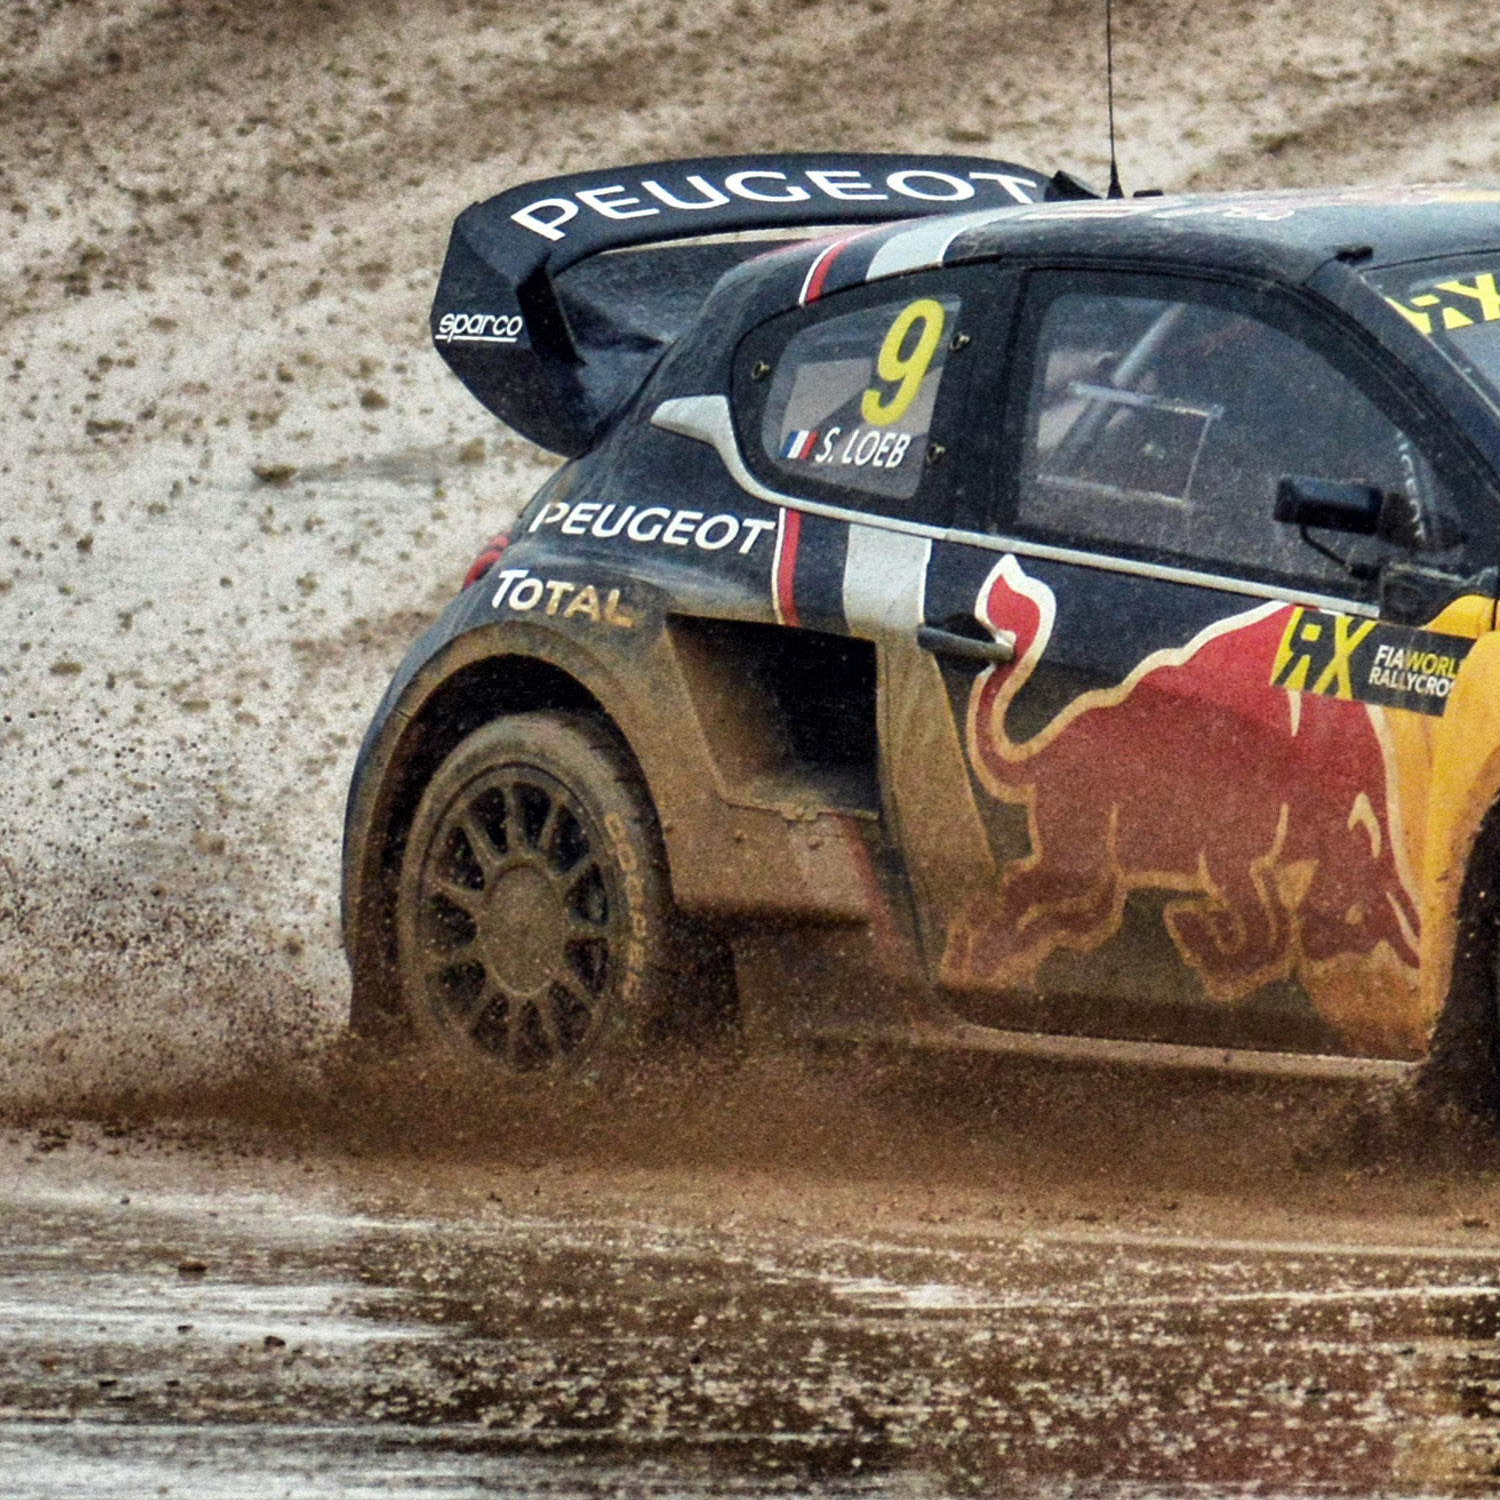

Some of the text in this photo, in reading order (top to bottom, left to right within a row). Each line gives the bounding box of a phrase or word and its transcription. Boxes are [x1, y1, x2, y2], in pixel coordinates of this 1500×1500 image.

[510, 170, 1037, 241] PEUGEOT
[435, 313, 523, 343] sparco
[861, 299, 945, 426] 9
[814, 426, 911, 468] S. LOEB
[528, 502, 776, 554] PEUGEOT
[491, 569, 633, 628] TOTAL
[1405, 650, 1461, 680] WORL
